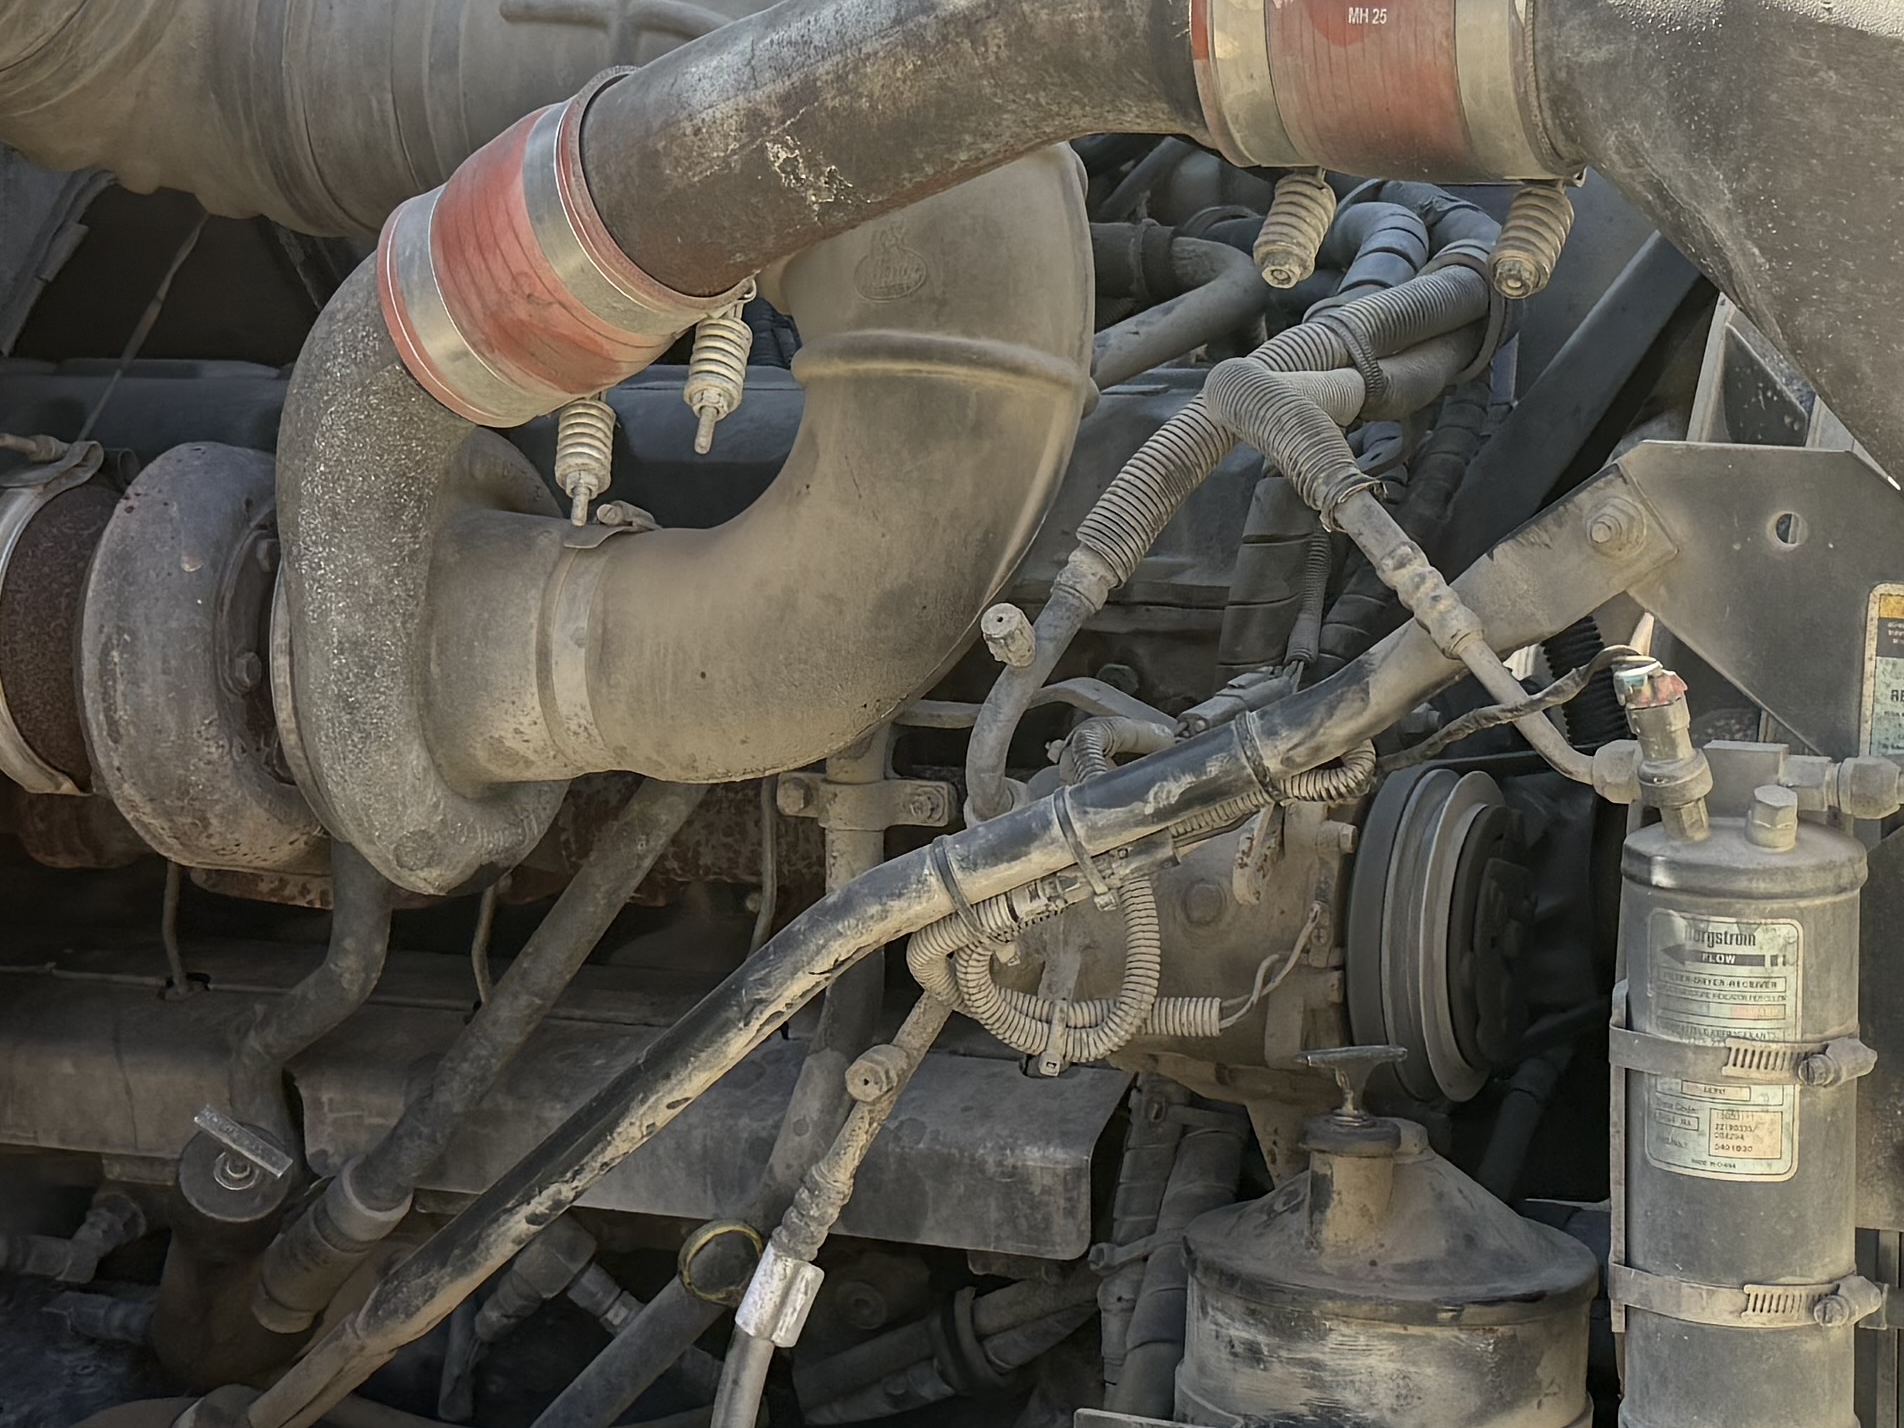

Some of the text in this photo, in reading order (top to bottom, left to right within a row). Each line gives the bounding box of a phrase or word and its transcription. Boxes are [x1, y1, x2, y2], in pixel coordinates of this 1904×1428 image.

[1348, 6, 1387, 25] MH 25
[1701, 952, 1737, 965] FLOW
